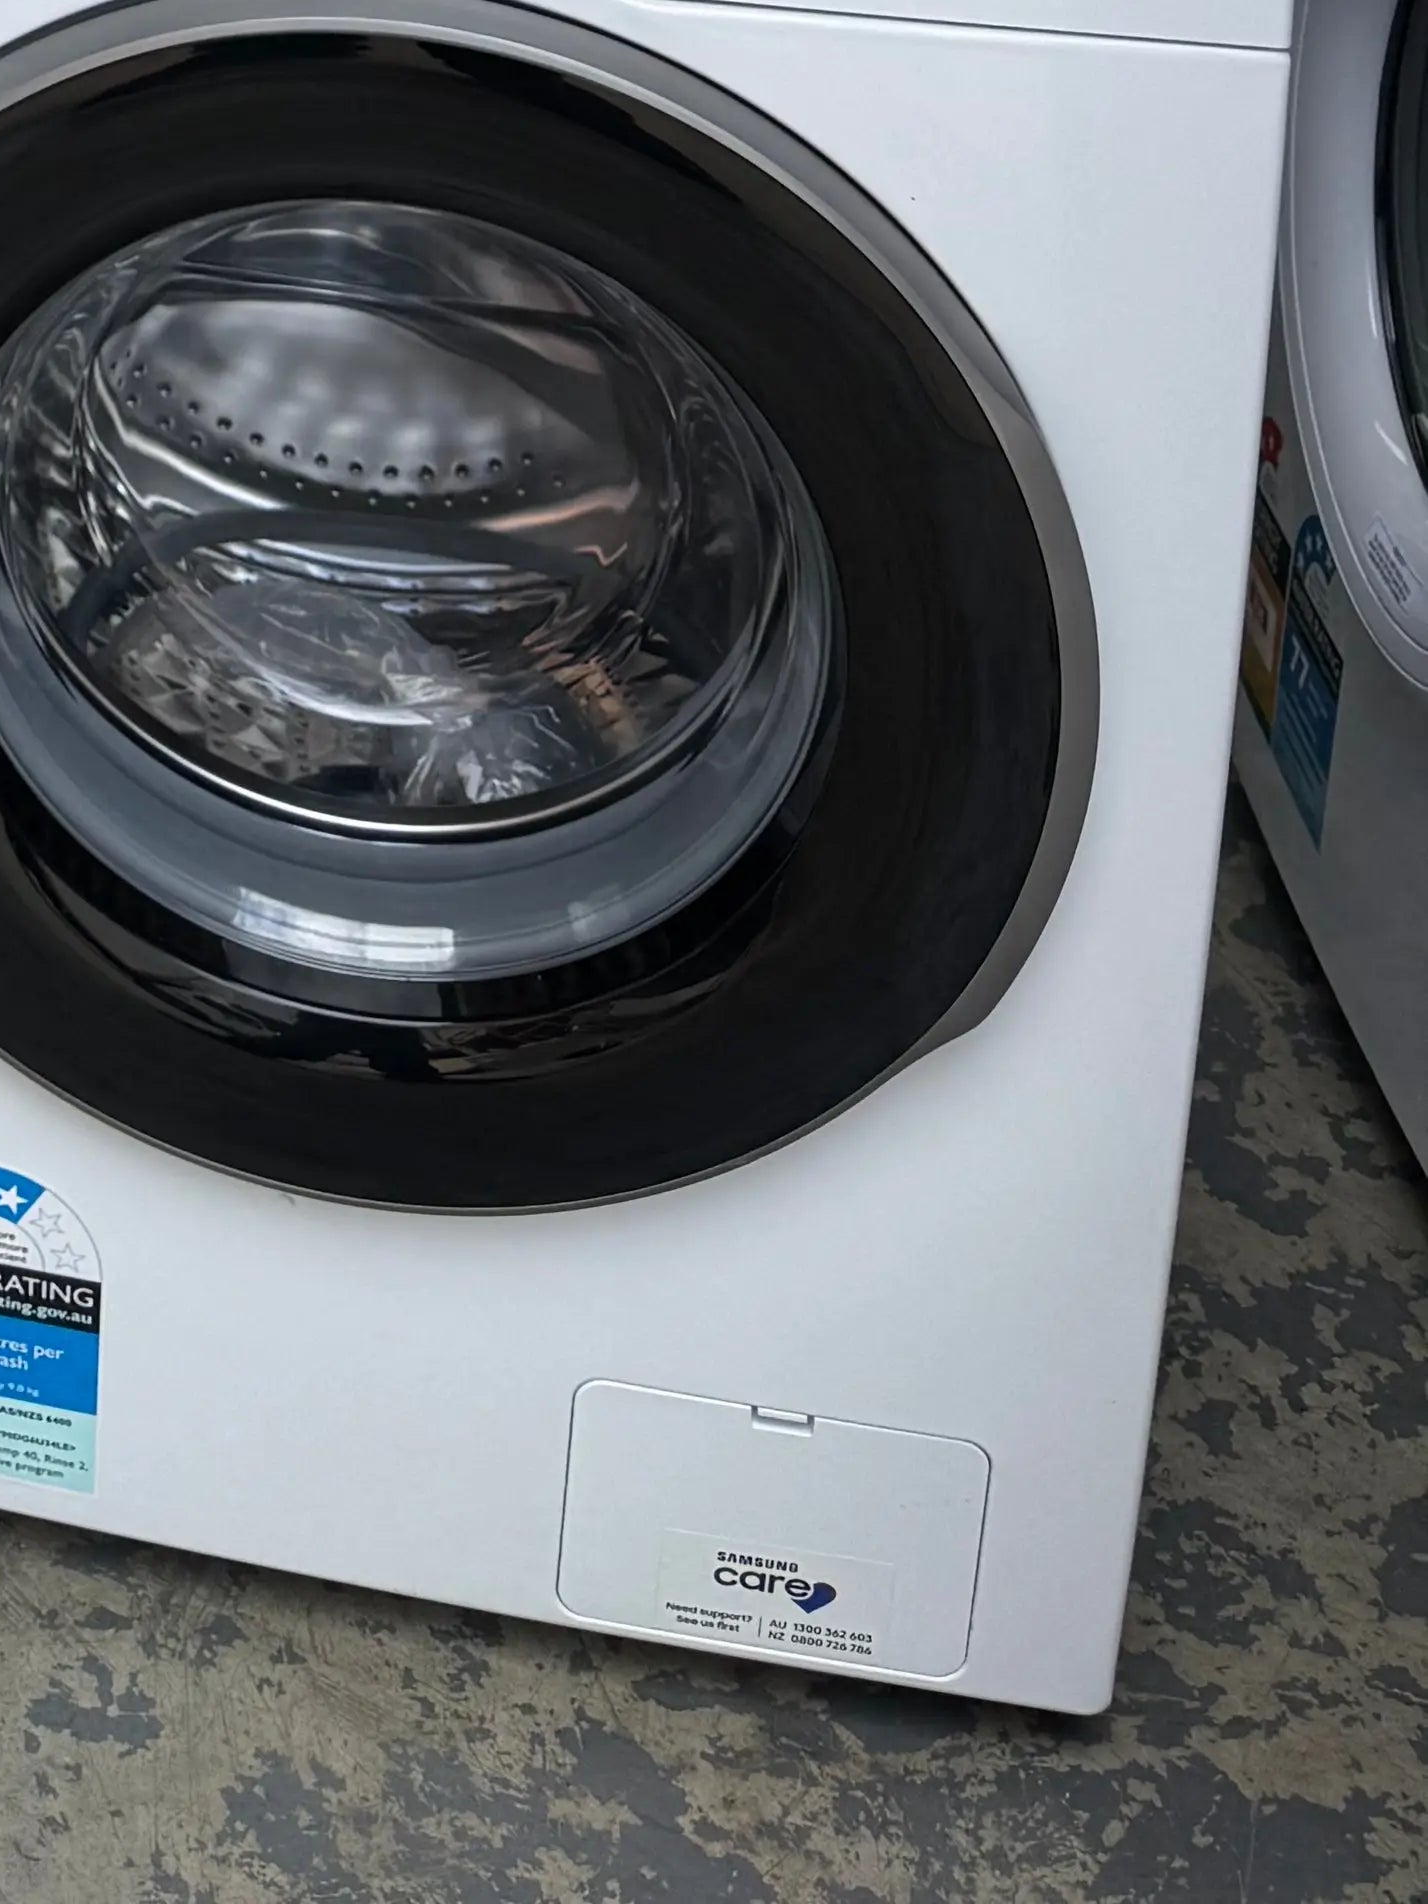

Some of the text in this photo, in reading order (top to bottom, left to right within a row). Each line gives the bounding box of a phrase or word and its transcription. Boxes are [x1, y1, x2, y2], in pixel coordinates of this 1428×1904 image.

[33, 1344, 64, 1360] per
[15, 1462, 64, 1479] program
[44, 1454, 75, 1469] Rinse
[716, 1551, 799, 1573] SAMSUNG
[713, 1566, 812, 1598] care
[665, 1602, 753, 1625] Need support?
[676, 1614, 740, 1633] See us first
[769, 1619, 873, 1643] AU 1300 362 603
[768, 1631, 786, 1641] NZ
[791, 1634, 823, 1648] 0800
